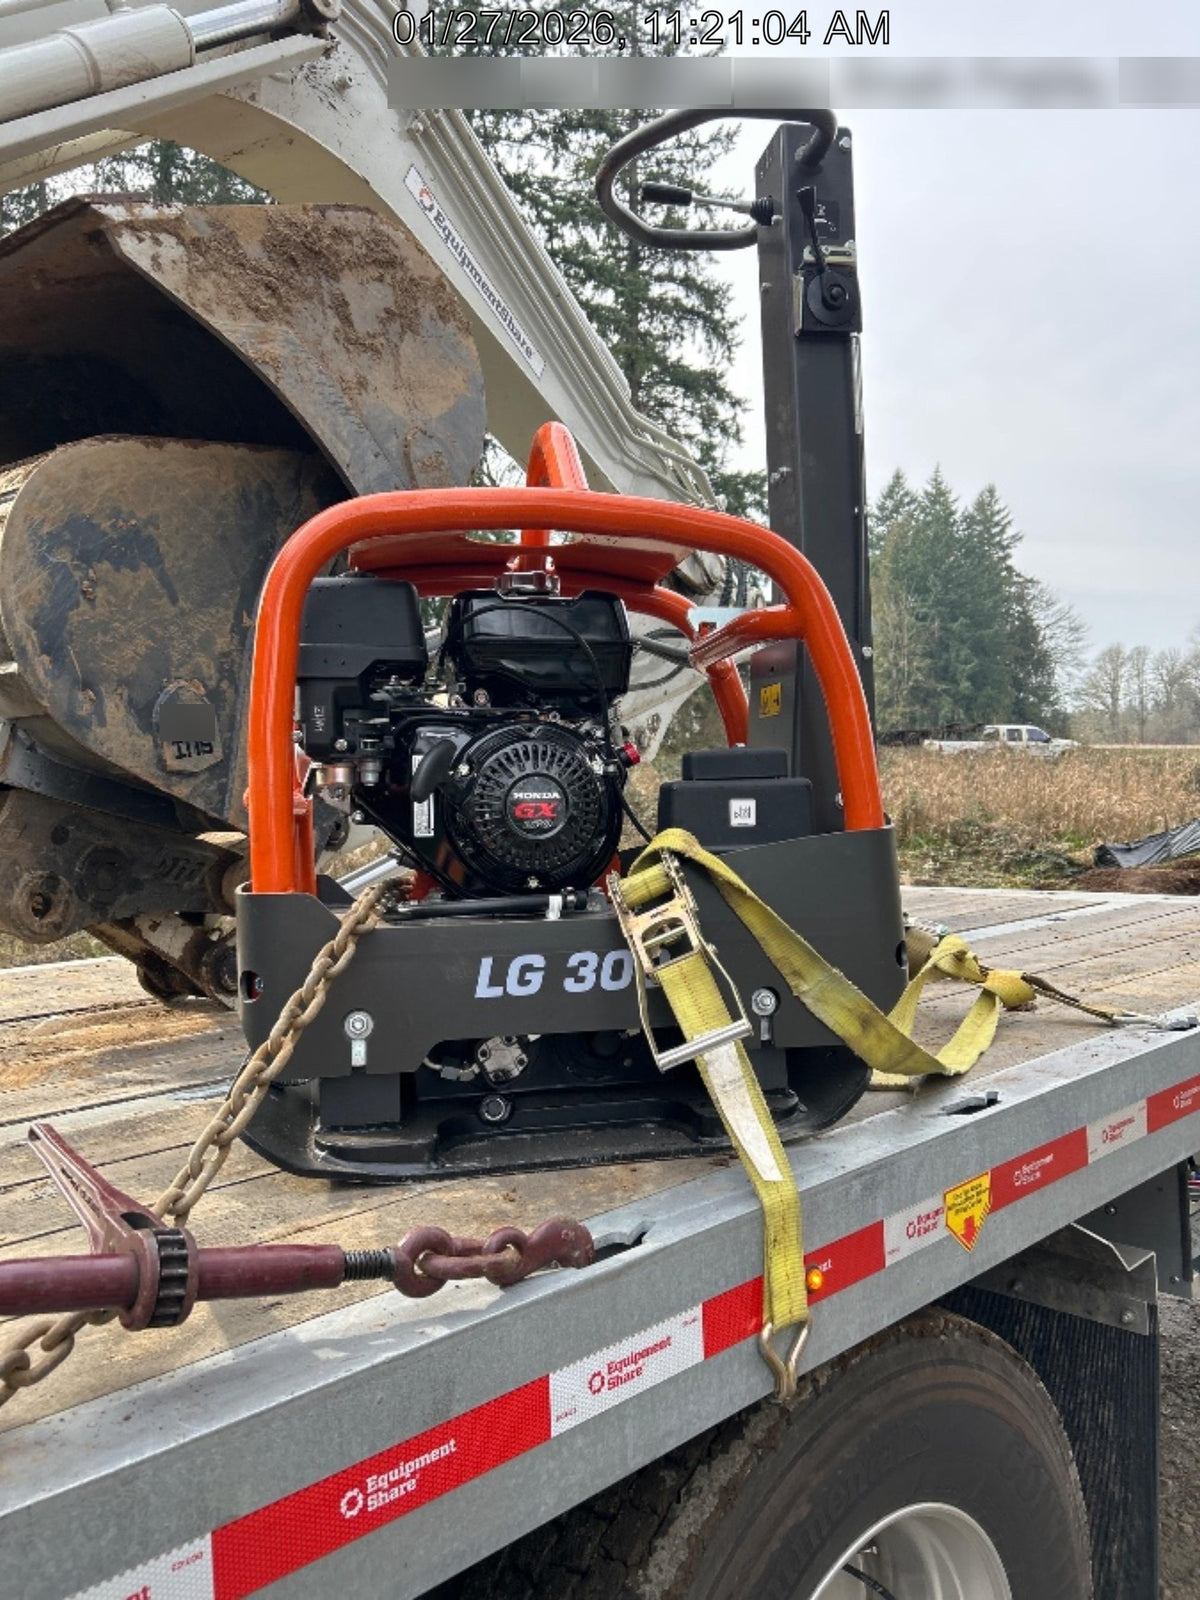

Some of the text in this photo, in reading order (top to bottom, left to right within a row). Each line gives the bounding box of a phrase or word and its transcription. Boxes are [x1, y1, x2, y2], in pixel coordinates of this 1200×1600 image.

[433, 209, 533, 359] EquipmentShare
[514, 802, 558, 819] GX
[474, 953, 546, 999] LG
[606, 1336, 672, 1375] Equipment
[607, 1366, 644, 1391] Share
[365, 1438, 457, 1494] Equipment
[366, 1478, 418, 1512] Share
